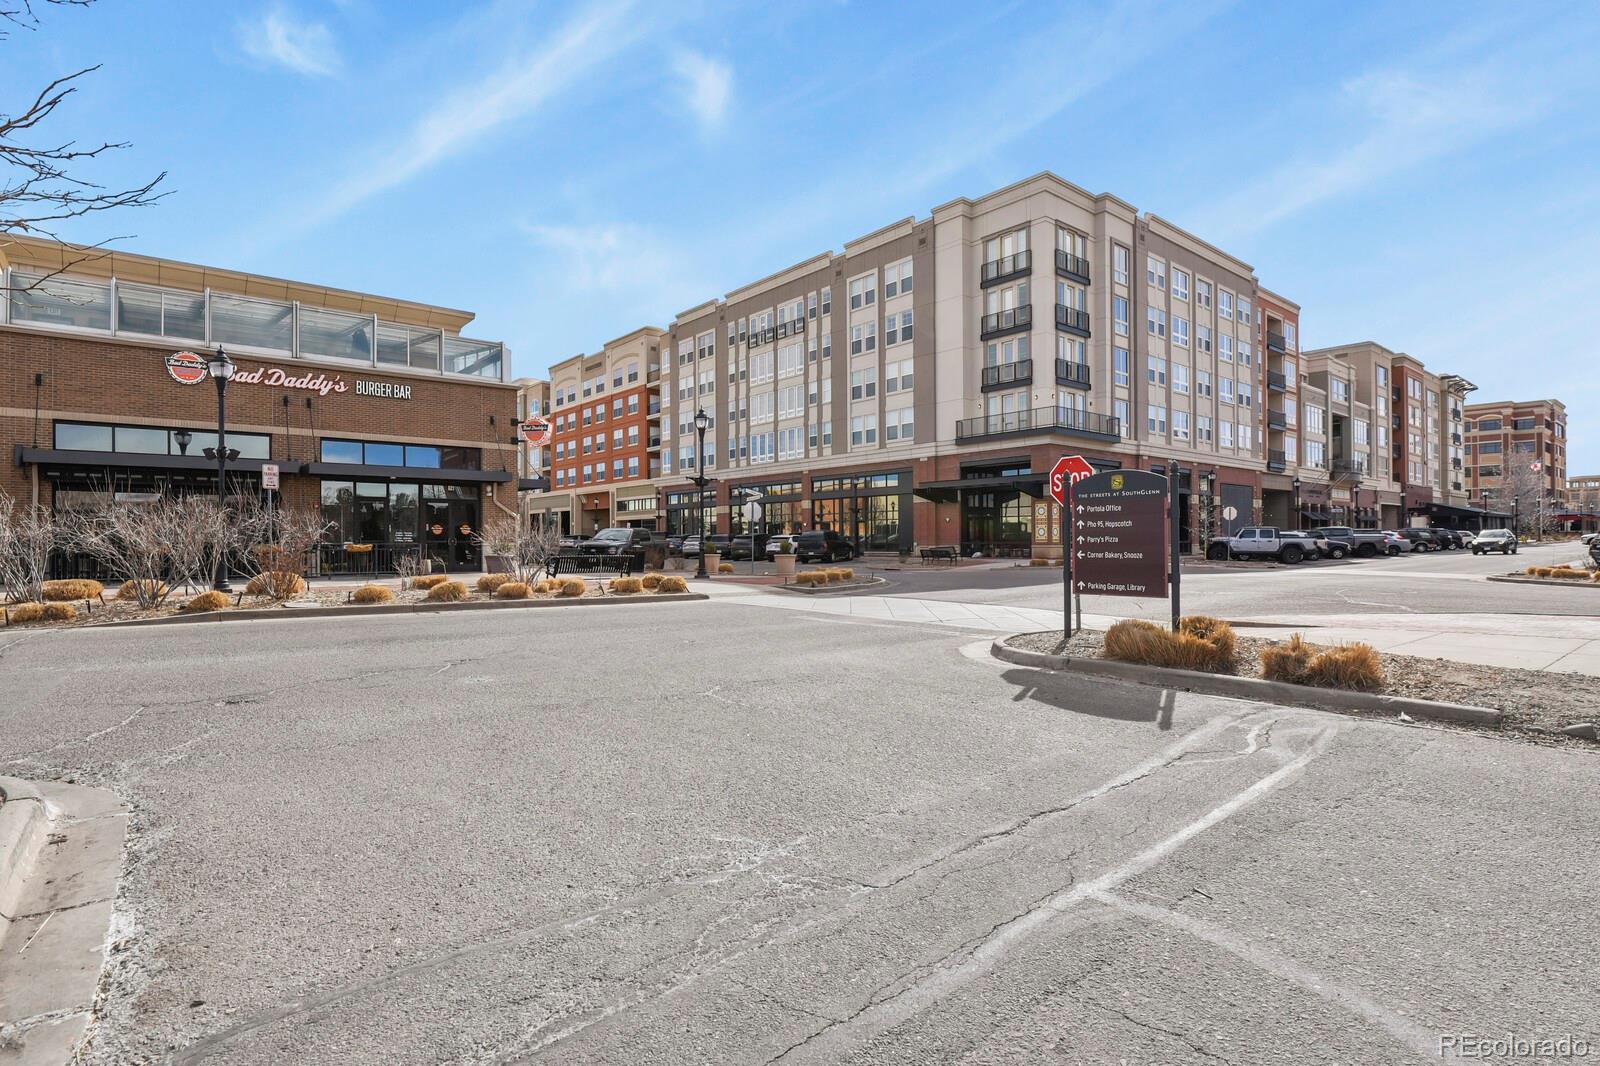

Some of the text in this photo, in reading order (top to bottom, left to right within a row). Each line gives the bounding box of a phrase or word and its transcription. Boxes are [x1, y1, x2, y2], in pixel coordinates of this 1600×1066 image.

[264, 368, 349, 396] Daddy's
[356, 380, 411, 399] BURGER BAR
[1105, 520, 1132, 528] Hopscotch
[1104, 551, 1123, 559] Bakery,
[1123, 551, 1143, 559] Snooze
[1087, 582, 1146, 592] Parking Garage, Library
